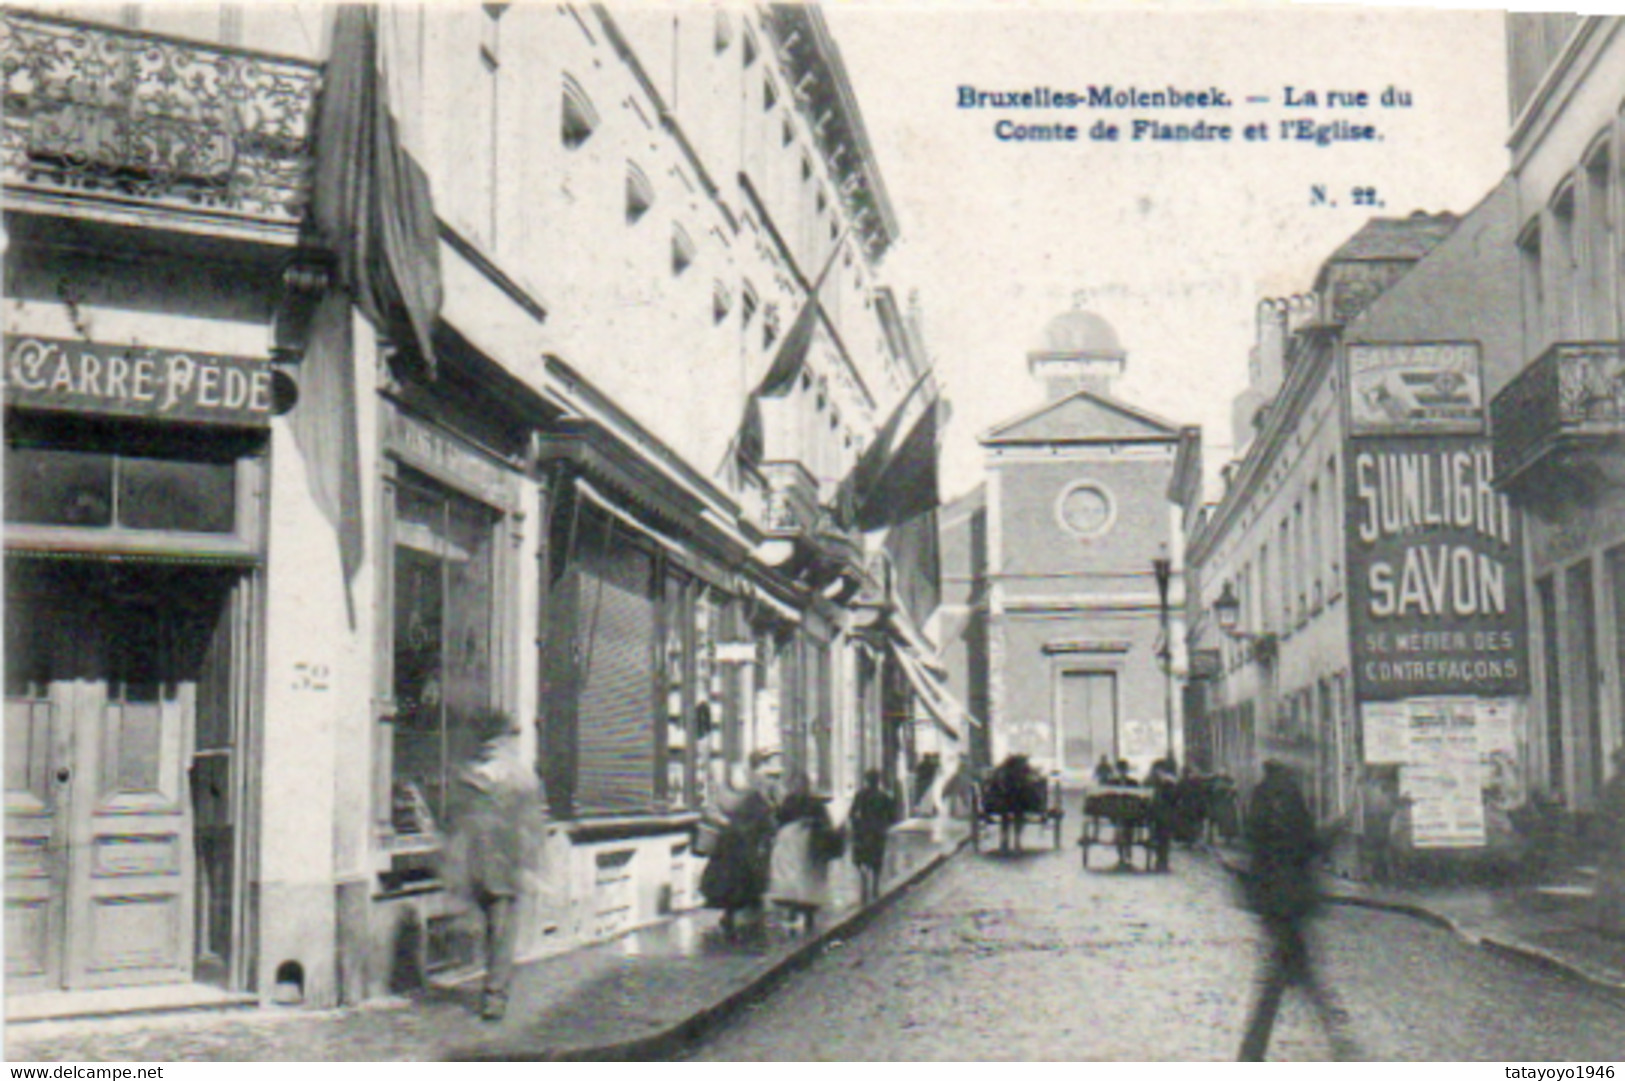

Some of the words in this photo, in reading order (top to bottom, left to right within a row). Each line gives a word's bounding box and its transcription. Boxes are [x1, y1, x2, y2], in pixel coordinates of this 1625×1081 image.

[1367, 544, 1507, 617] SAVON
[1473, 630, 1514, 650] DES
[1365, 657, 1519, 683] CONTREFAÇONS
